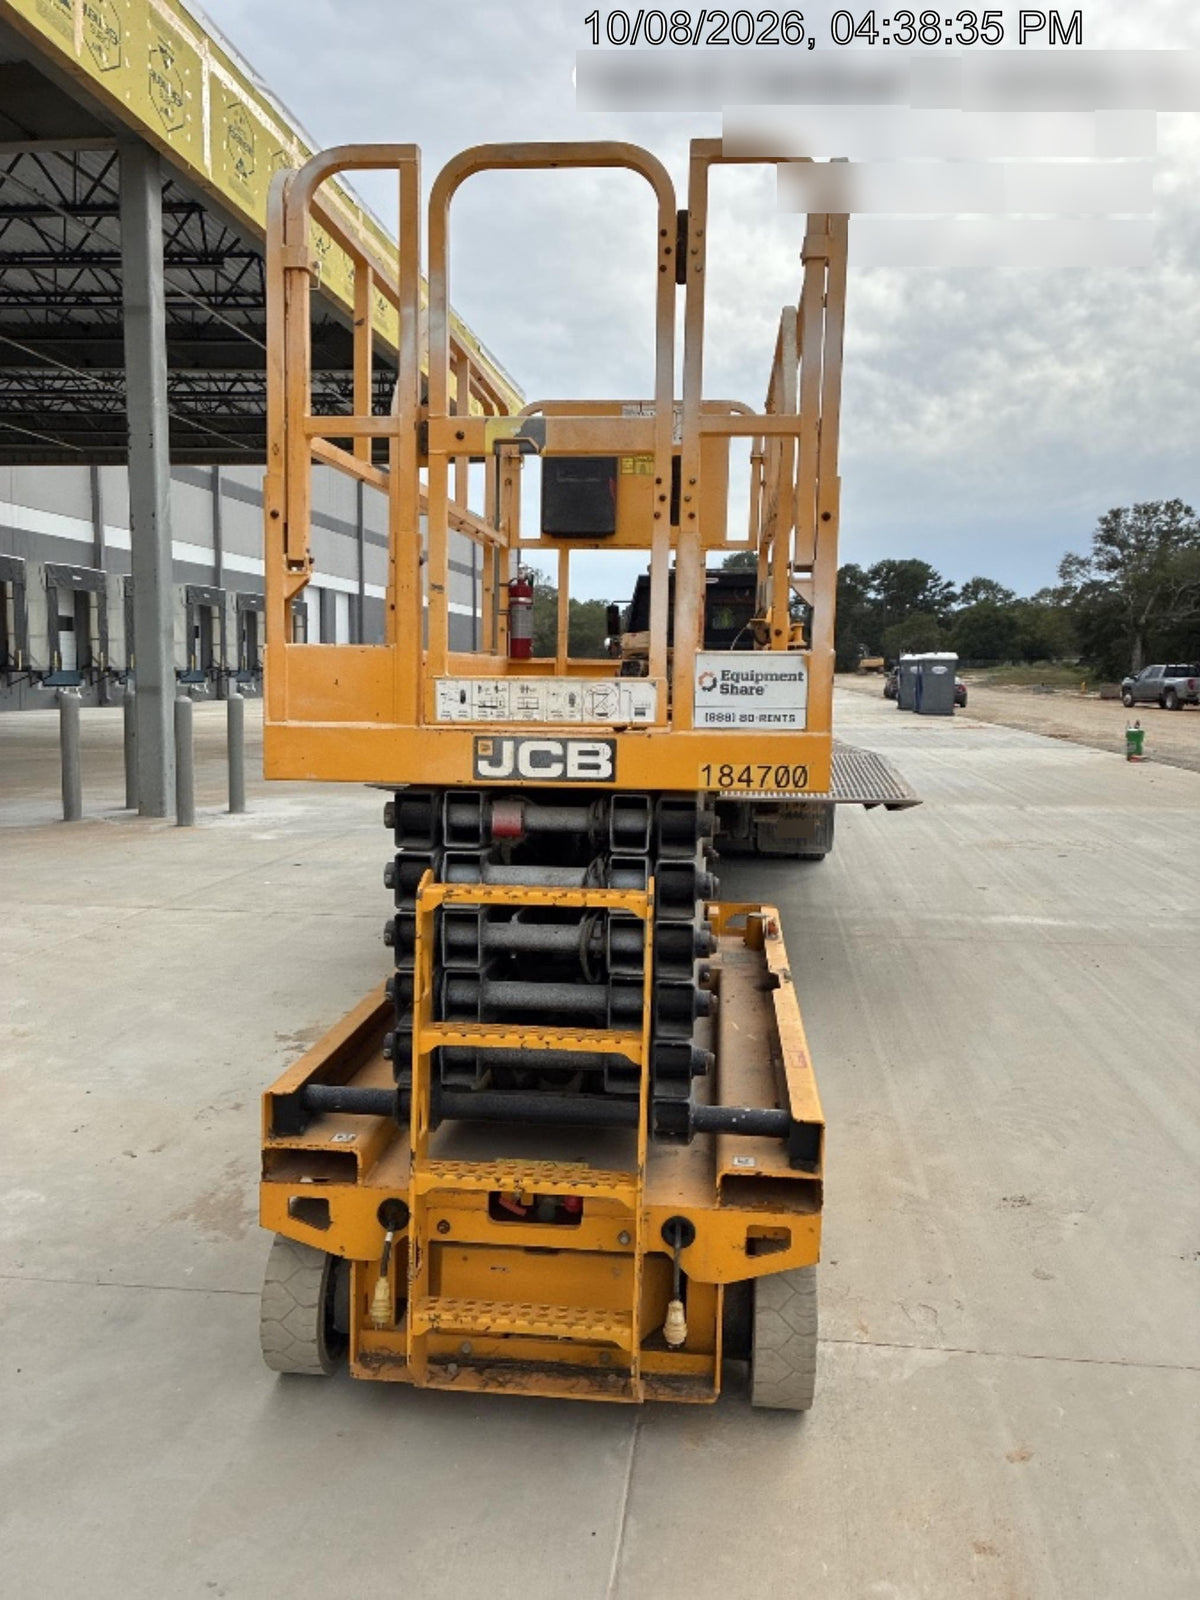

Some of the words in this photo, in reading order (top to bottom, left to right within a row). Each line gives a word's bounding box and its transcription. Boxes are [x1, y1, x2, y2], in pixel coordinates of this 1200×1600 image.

[720, 669, 804, 684] Equipment
[719, 683, 765, 696] Share
[477, 740, 613, 778] JCB
[701, 764, 808, 788] 184700
